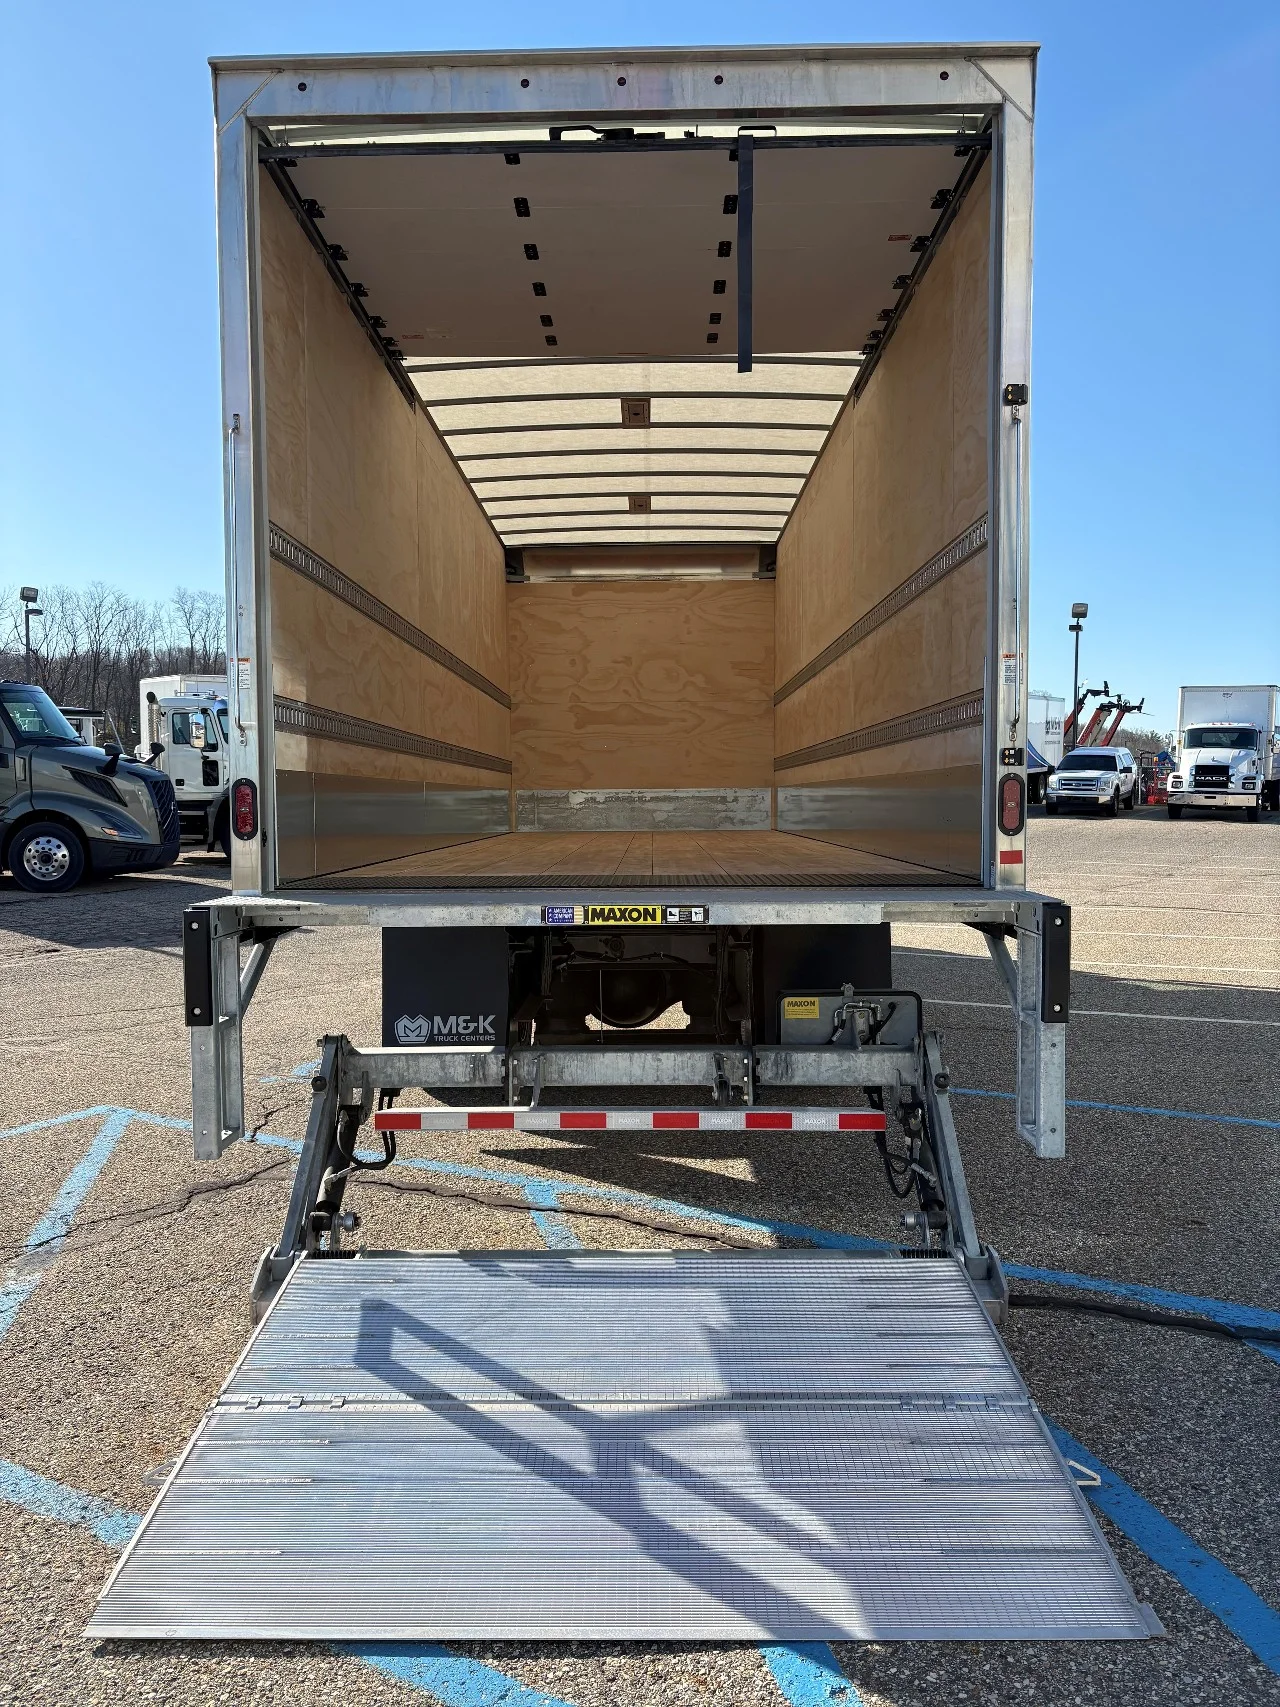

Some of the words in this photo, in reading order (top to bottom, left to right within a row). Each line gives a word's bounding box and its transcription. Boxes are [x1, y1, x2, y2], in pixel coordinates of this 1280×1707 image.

[590, 907, 657, 922] MAXON
[433, 1015, 496, 1034] M&K
[460, 1034, 496, 1042] CENTERS
